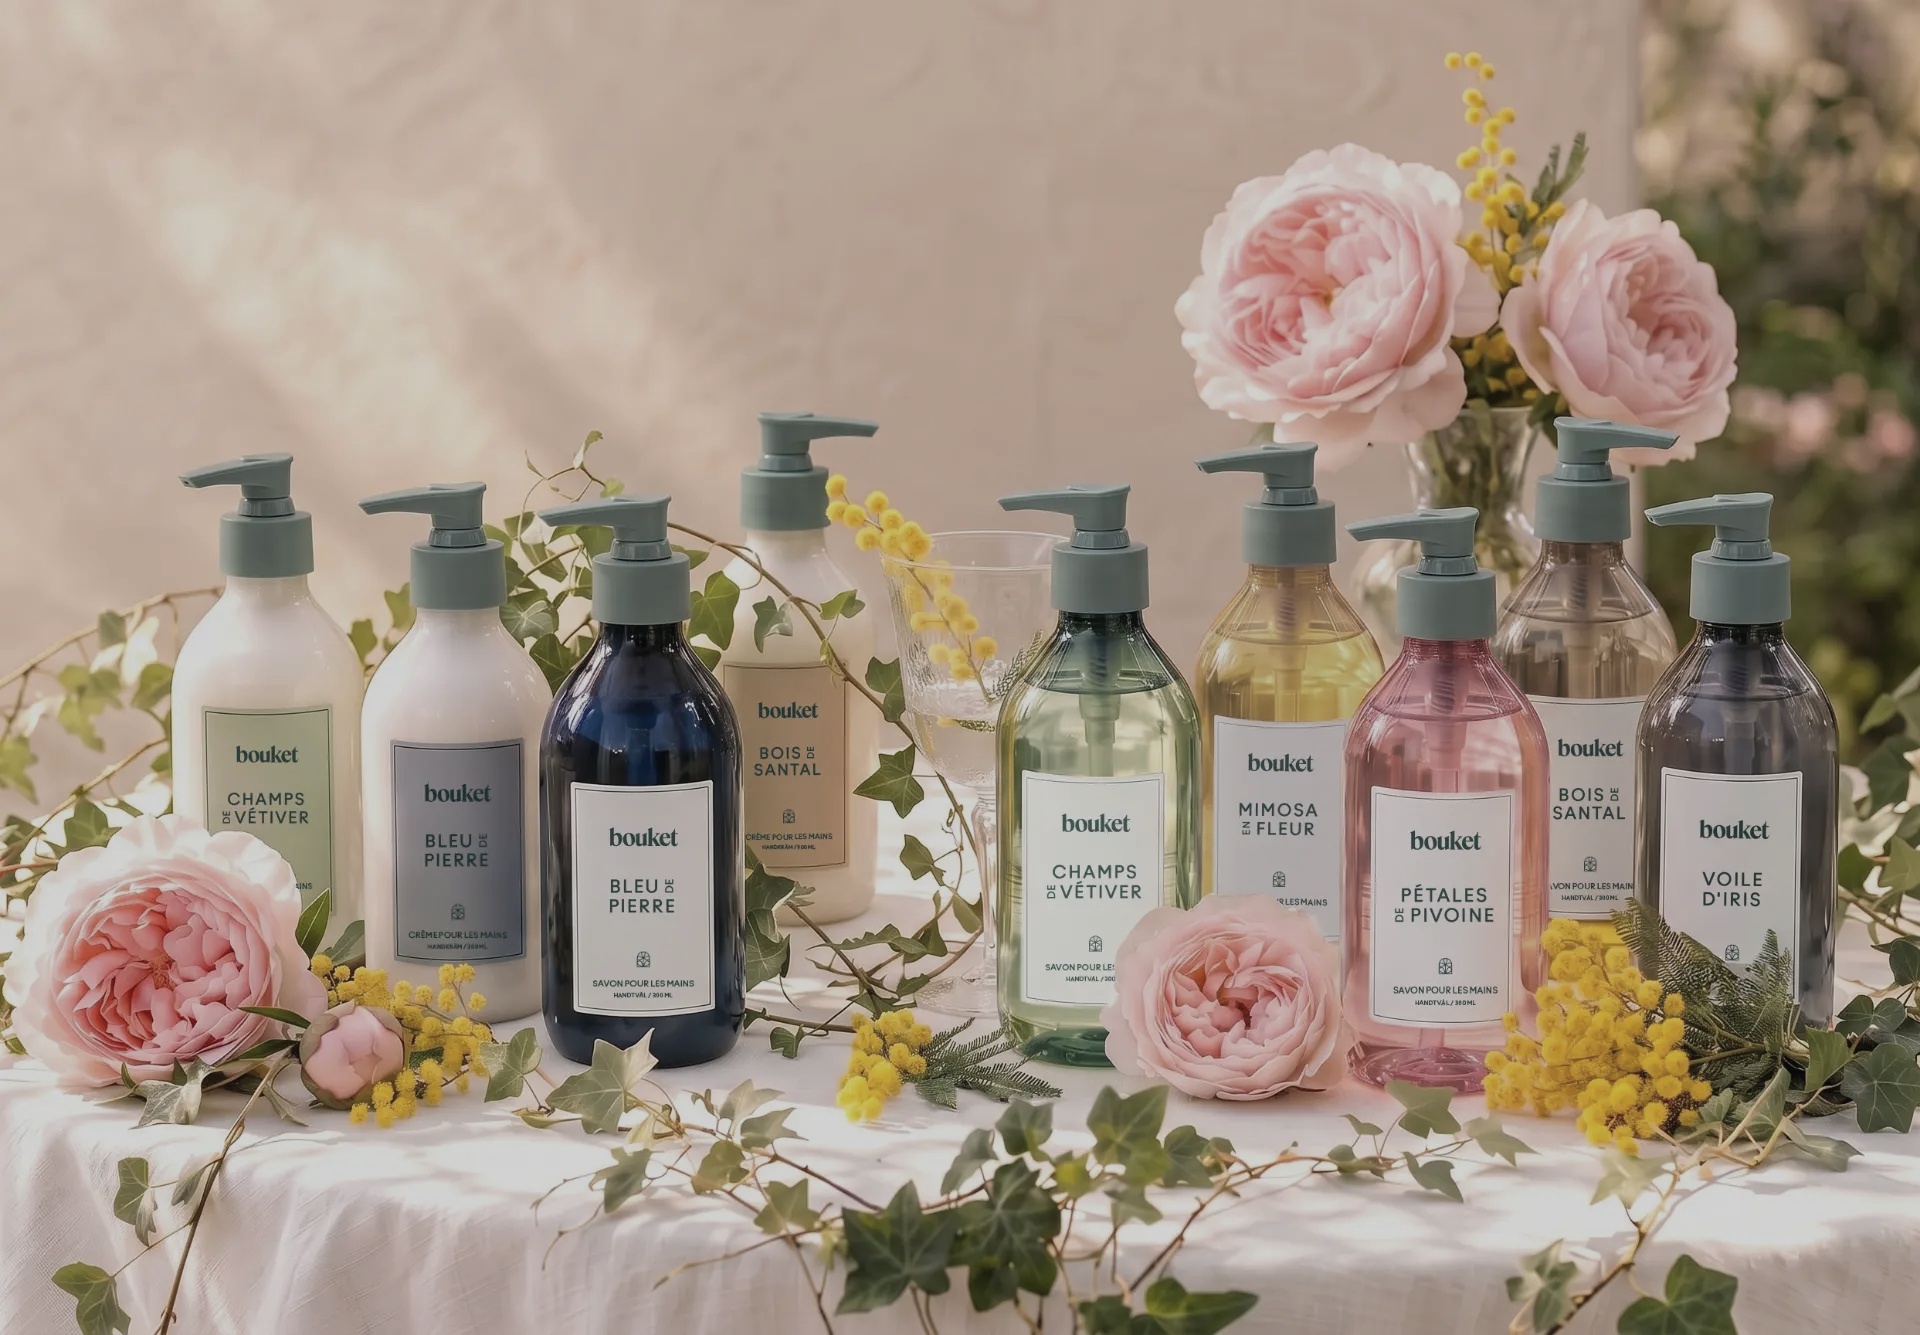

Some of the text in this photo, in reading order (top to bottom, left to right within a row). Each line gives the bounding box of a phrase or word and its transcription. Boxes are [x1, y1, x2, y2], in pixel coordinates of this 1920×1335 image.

[758, 702, 819, 719] bouket
[236, 745, 298, 763] bouket
[760, 746, 815, 760] BOIS DE
[1558, 738, 1623, 757] bouket
[754, 763, 821, 776] SANTAL
[1248, 753, 1314, 772] bouket
[227, 792, 304, 806] CHAMPS
[424, 783, 492, 803] bouket
[1559, 787, 1619, 802] BOIS DE
[222, 807, 309, 824] DE VÉTIVER
[1239, 802, 1318, 817] MIMOSA
[1553, 806, 1625, 820] SANTAL
[1061, 813, 1130, 833] bouket
[1242, 821, 1314, 836] EN FLEUR
[1700, 819, 1769, 839] bouket
[425, 833, 488, 848] BLEU DE
[609, 827, 678, 847] bouket
[745, 832, 770, 841] CRÈME
[772, 833, 793, 841] POUR
[1410, 830, 1482, 850] bouket
[424, 853, 489, 867] PIERRE
[1052, 864, 1136, 879] CHAMPS
[1702, 871, 1763, 887] VOILE
[610, 878, 674, 894] BLEU DE
[1046, 881, 1142, 899] DE VÉTIVER
[1401, 884, 1487, 903] PÉTALES
[1572, 882, 1596, 890] POUR
[1597, 882, 1611, 890] LES
[609, 899, 675, 913] PIERRE
[1285, 898, 1300, 906] LES
[1300, 898, 1328, 906] MAINS
[1702, 892, 1761, 907] D'IRIS
[1394, 908, 1494, 923] DE PIVOINE
[408, 930, 508, 939] CRÈME POUR LES MAINS
[1045, 963, 1075, 971] SAVON
[1077, 963, 1101, 971] POUR
[592, 979, 695, 988] SAVON POUR LES MAINS
[1393, 986, 1498, 994] SAVON POUR LES MAINS
